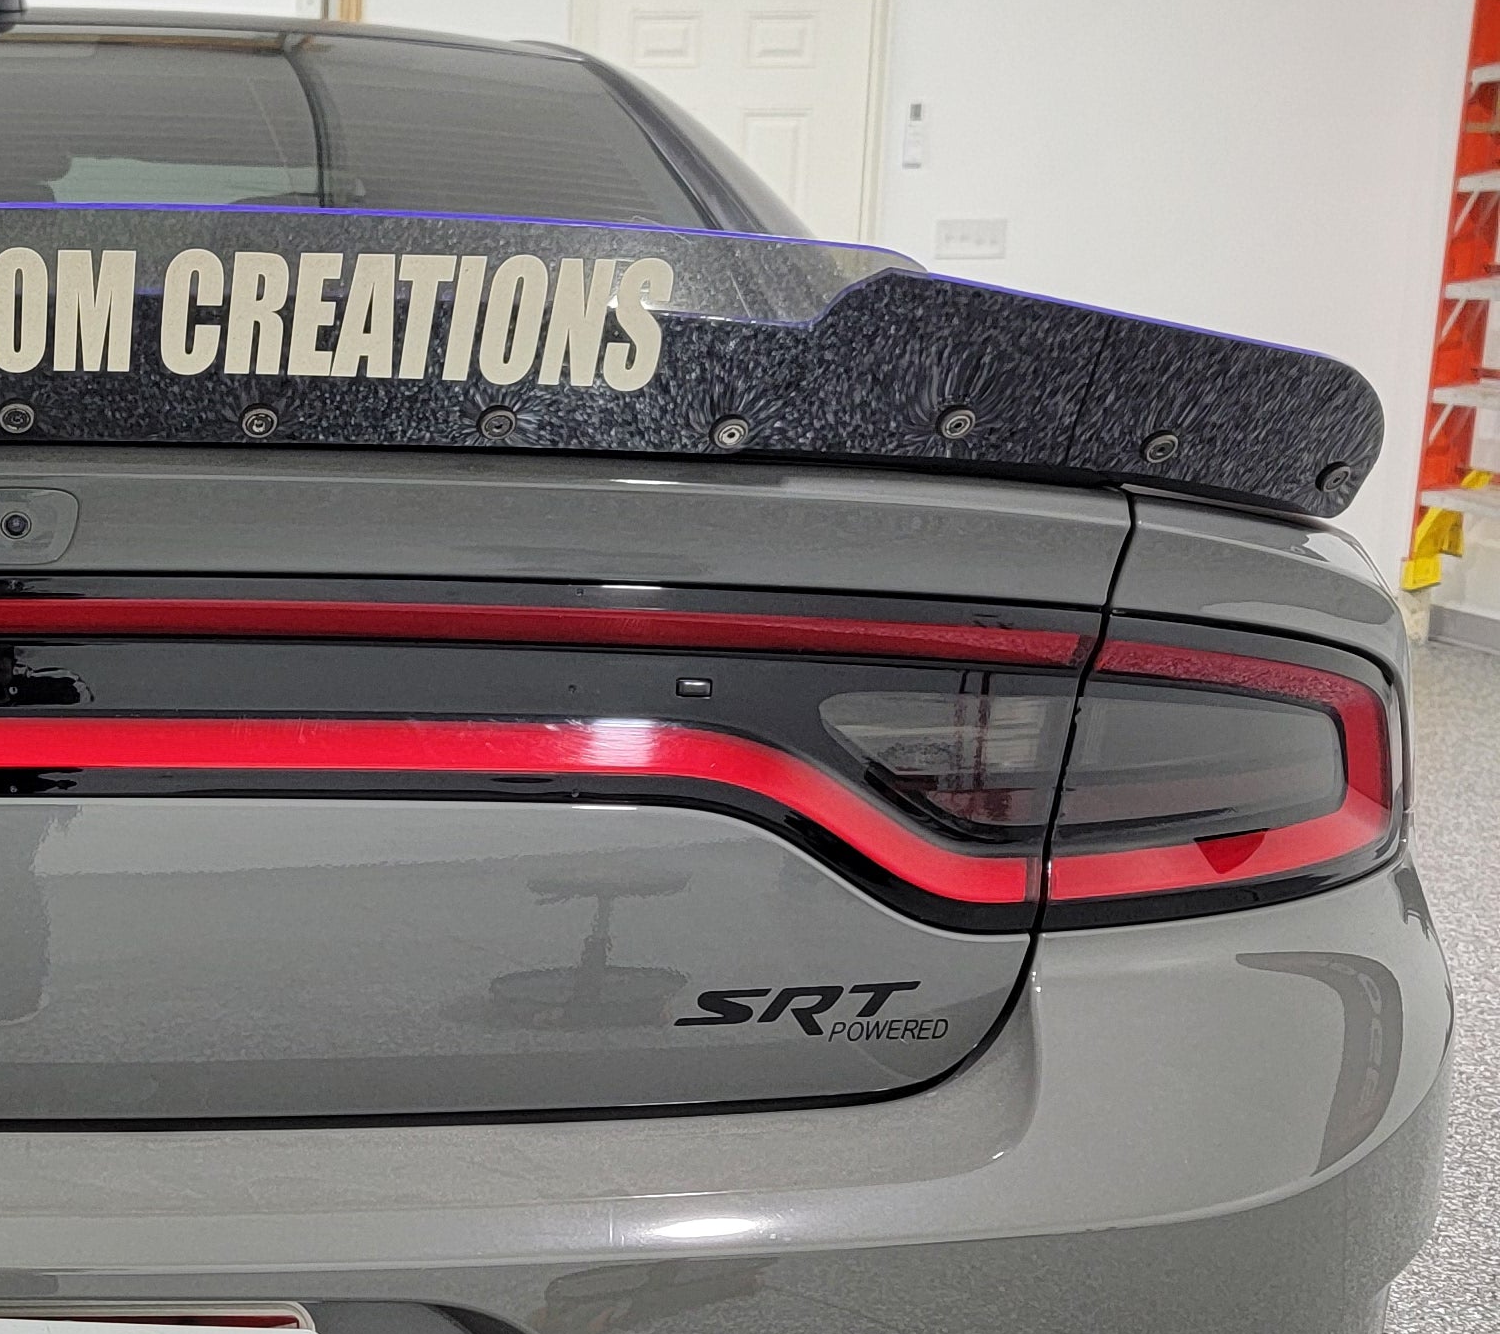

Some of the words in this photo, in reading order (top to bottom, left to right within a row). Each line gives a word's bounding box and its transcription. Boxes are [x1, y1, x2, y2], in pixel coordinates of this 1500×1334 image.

[159, 248, 674, 393] CREATIONS
[673, 980, 922, 1036] SRT
[827, 1017, 949, 1043] POWERED
